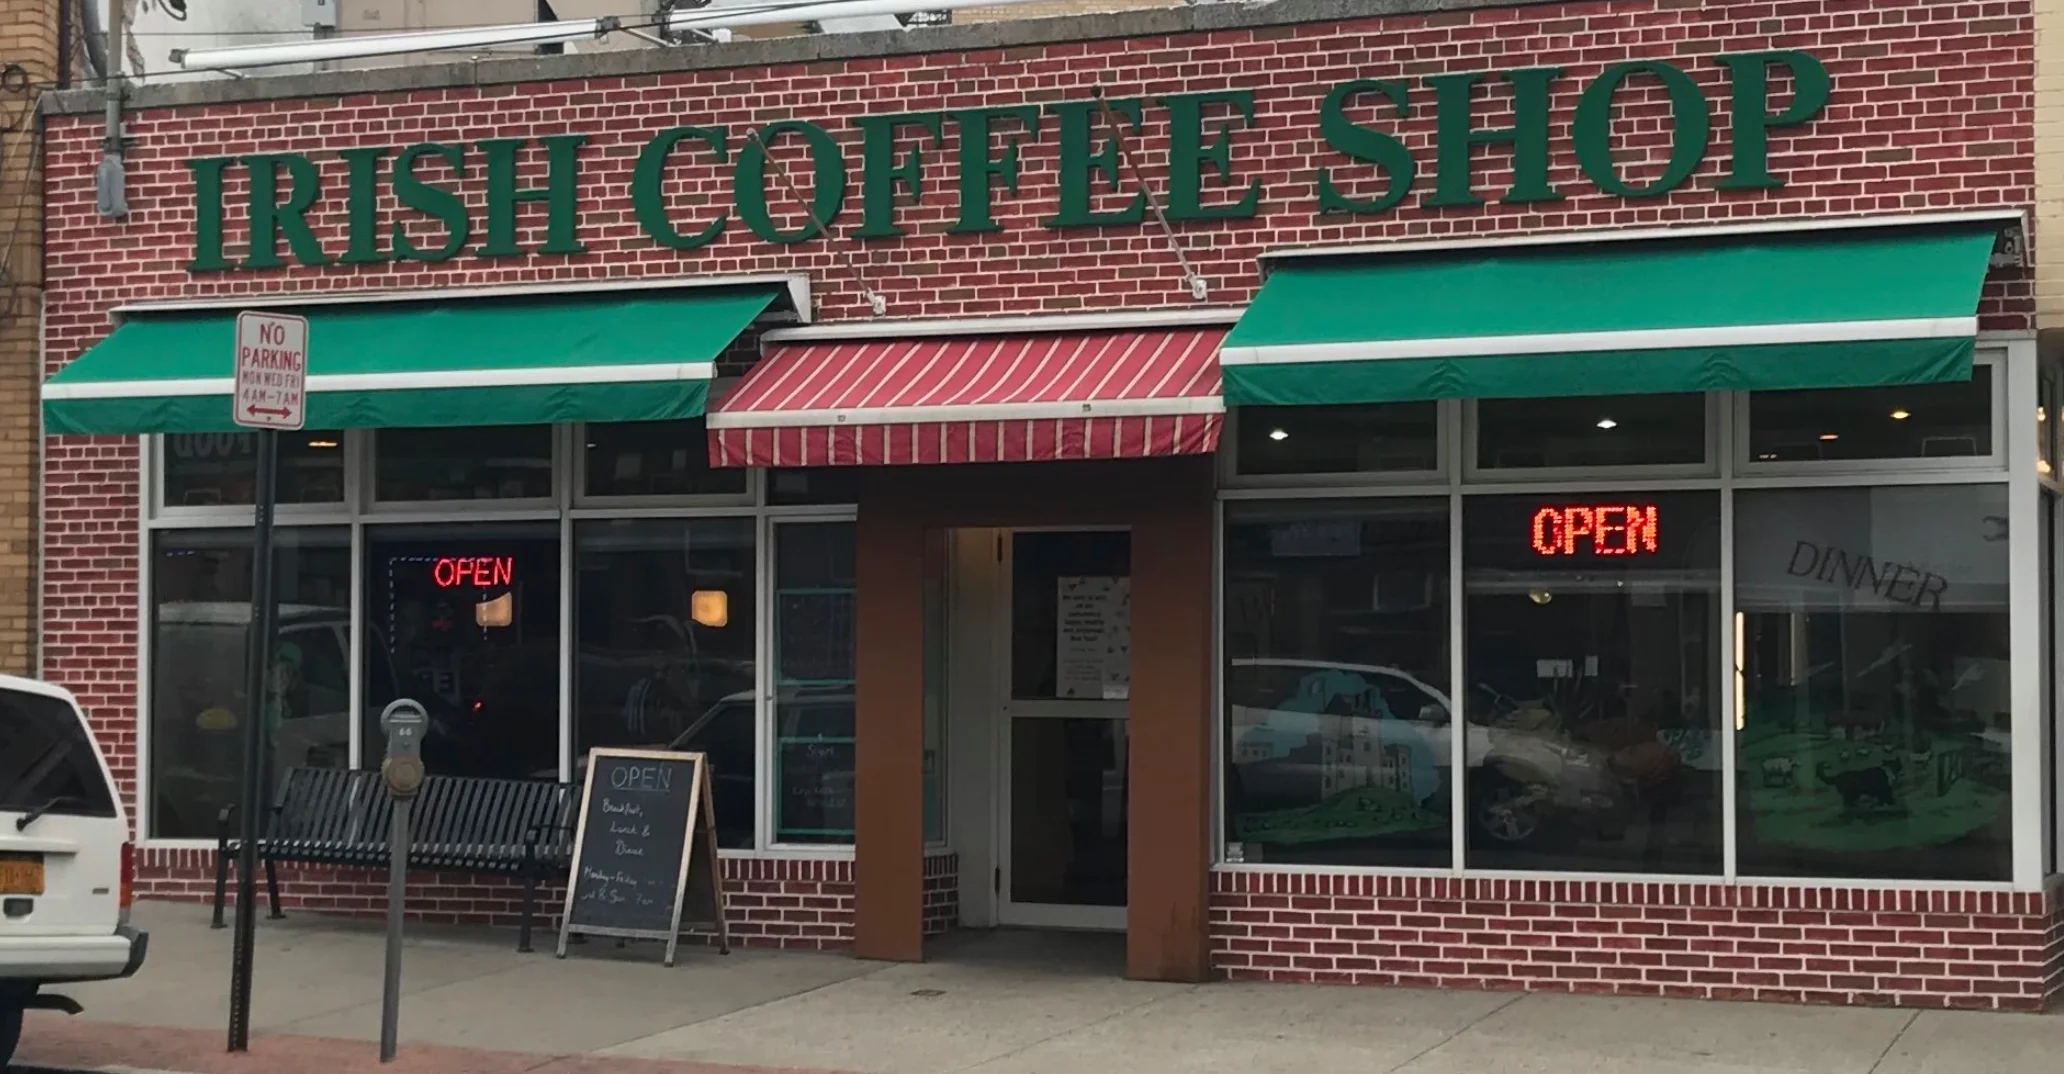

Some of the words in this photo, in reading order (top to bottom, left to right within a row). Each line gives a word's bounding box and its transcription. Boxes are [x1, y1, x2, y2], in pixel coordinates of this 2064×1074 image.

[186, 135, 588, 272] IRISH
[632, 90, 1261, 249] COFFEE
[1318, 50, 1830, 214] SHOP
[259, 323, 285, 345] NO
[242, 347, 301, 372] PARKING
[242, 371, 261, 385] MON
[263, 371, 283, 387] WED
[286, 374, 300, 389] FRI
[1532, 505, 1659, 556] OPEN
[433, 556, 513, 588] OPEN
[1786, 540, 1949, 611] DINNER
[611, 763, 673, 790] OPEN
